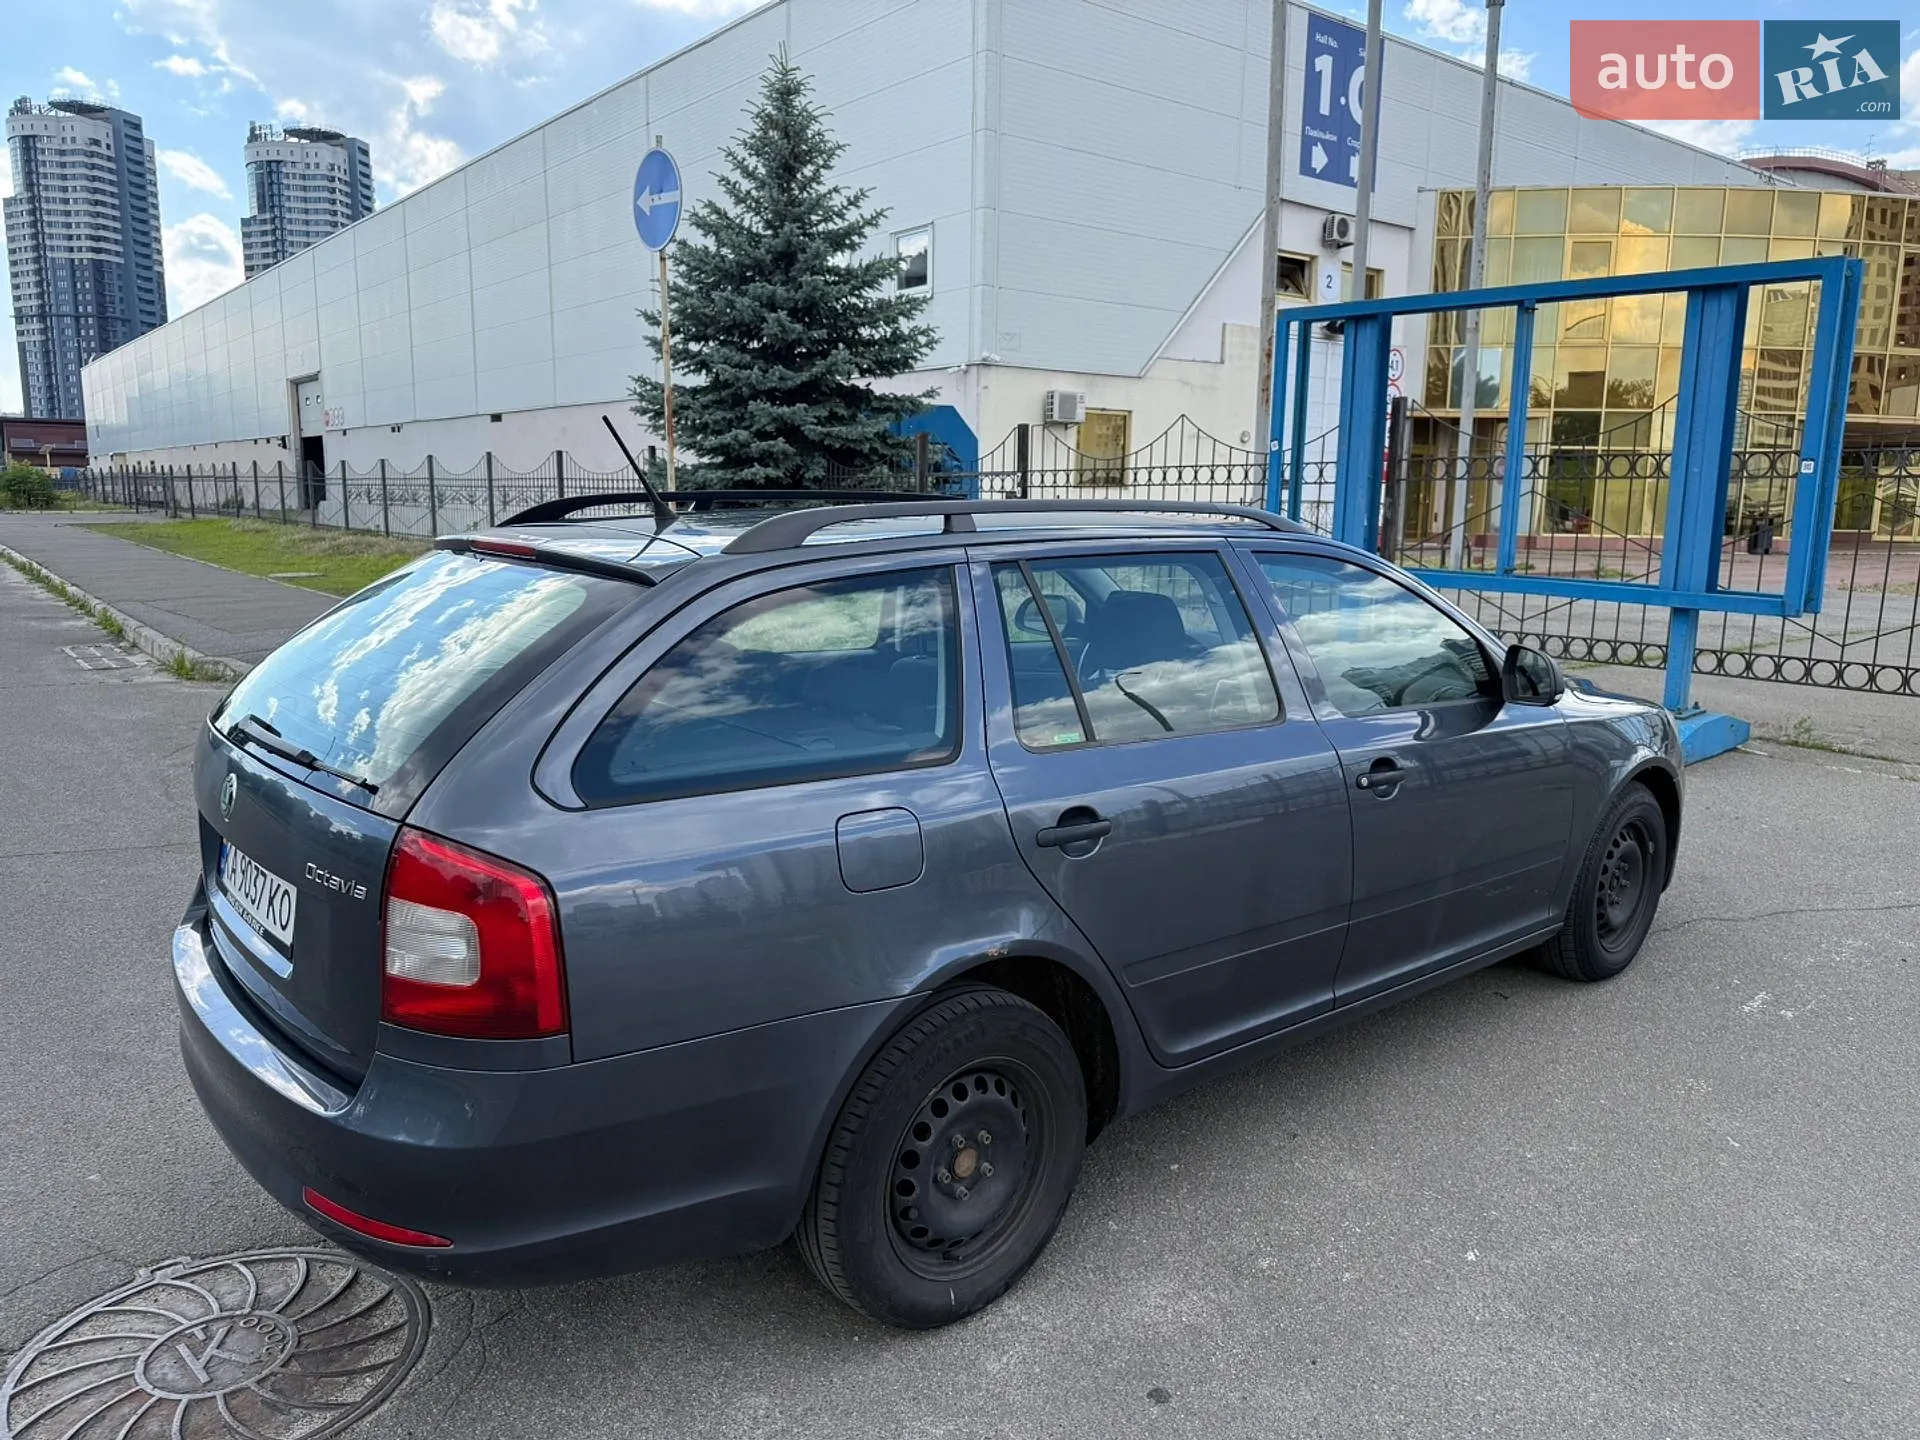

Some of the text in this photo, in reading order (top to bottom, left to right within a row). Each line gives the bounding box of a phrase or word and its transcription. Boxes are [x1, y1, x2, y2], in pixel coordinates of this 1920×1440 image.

[1326, 274, 1333, 289] 2
[238, 855, 268, 910] 9037
[266, 882, 291, 931] KO
[305, 862, 368, 900] Octavia
